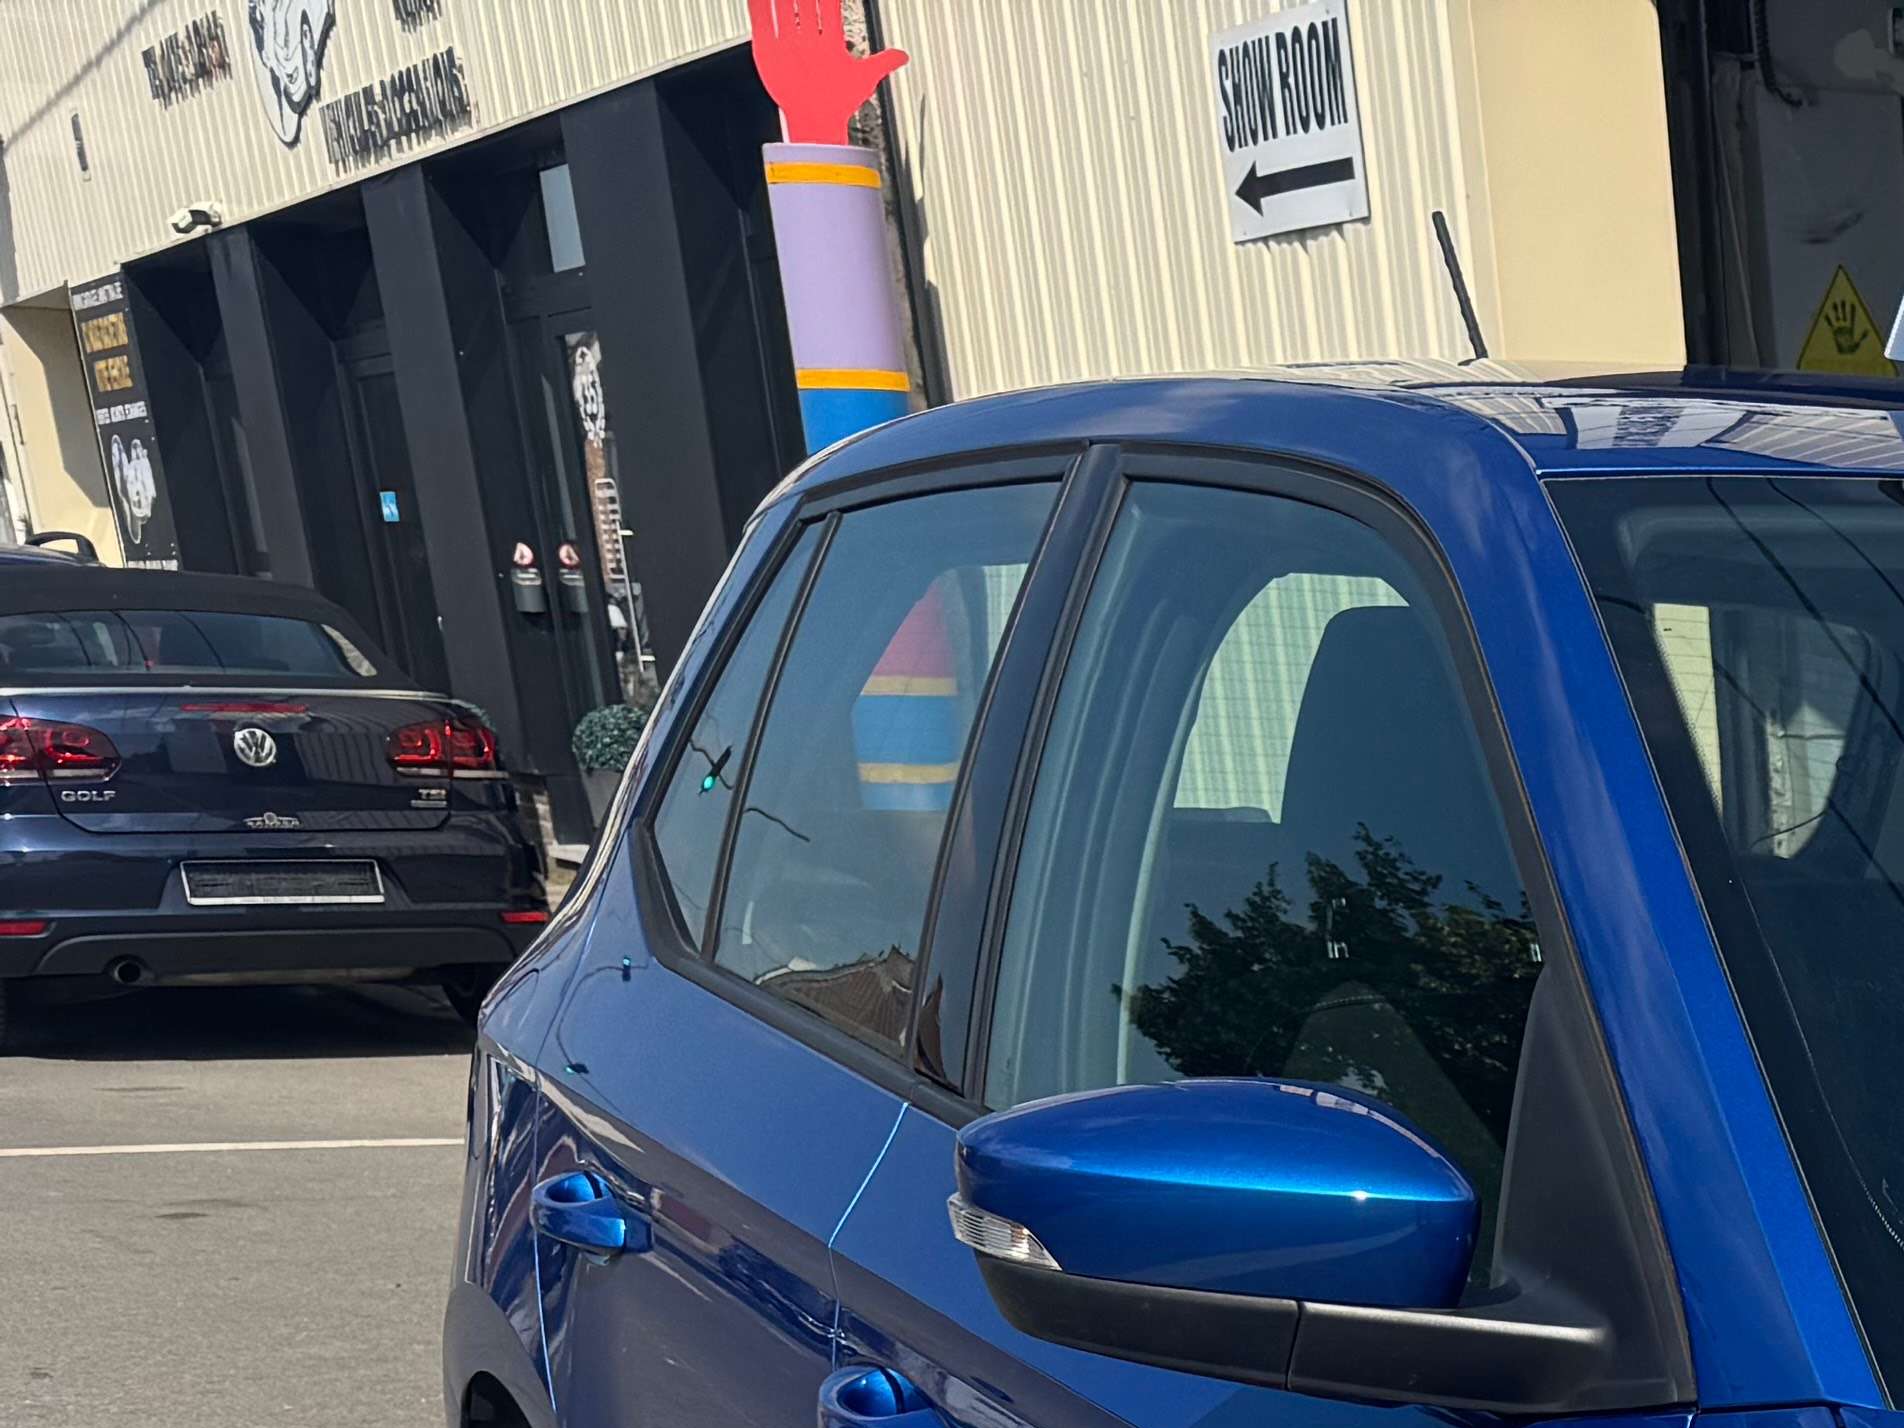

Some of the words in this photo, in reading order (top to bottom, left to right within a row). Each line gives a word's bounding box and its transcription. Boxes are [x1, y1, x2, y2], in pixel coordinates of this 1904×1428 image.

[1217, 34, 1279, 153] SHOW
[1275, 16, 1349, 137] ROOM
[60, 789, 117, 803] GOLF
